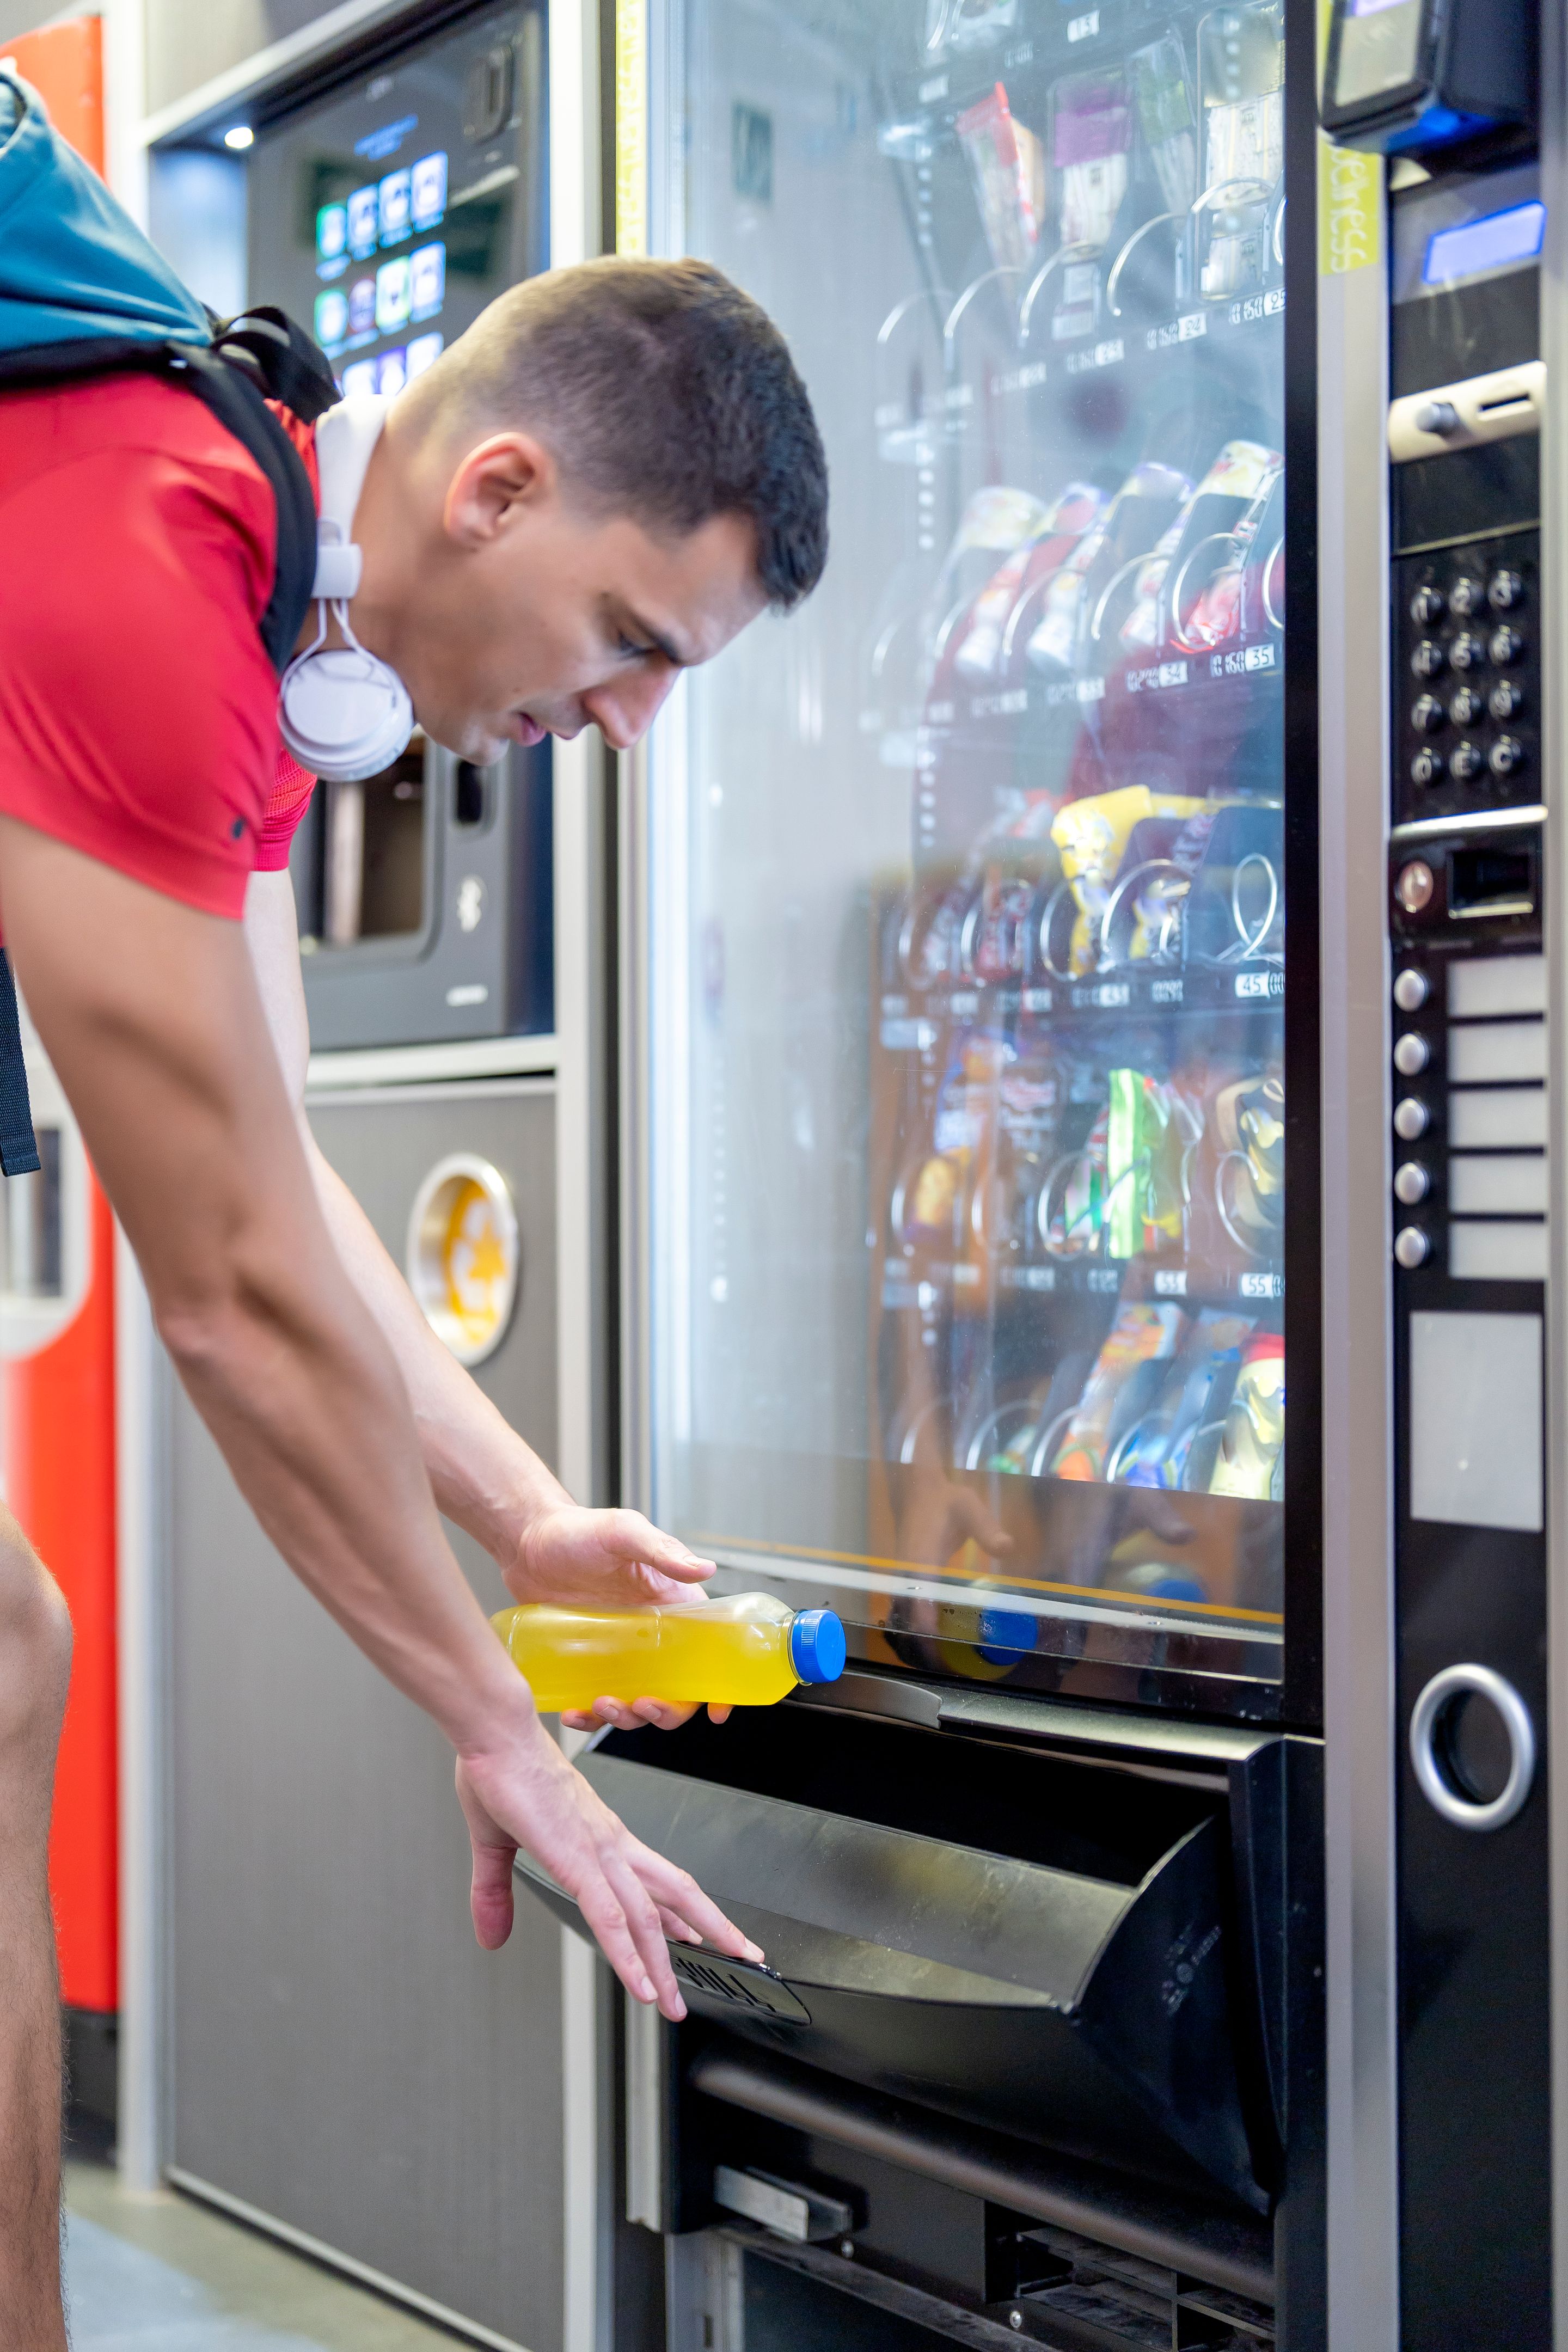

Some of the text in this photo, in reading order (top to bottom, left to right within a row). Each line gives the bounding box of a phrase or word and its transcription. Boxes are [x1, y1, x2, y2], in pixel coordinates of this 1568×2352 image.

[1252, 647, 1269, 667] 35
[1243, 975, 1260, 994] 45
[1250, 1276, 1266, 1294] 55
